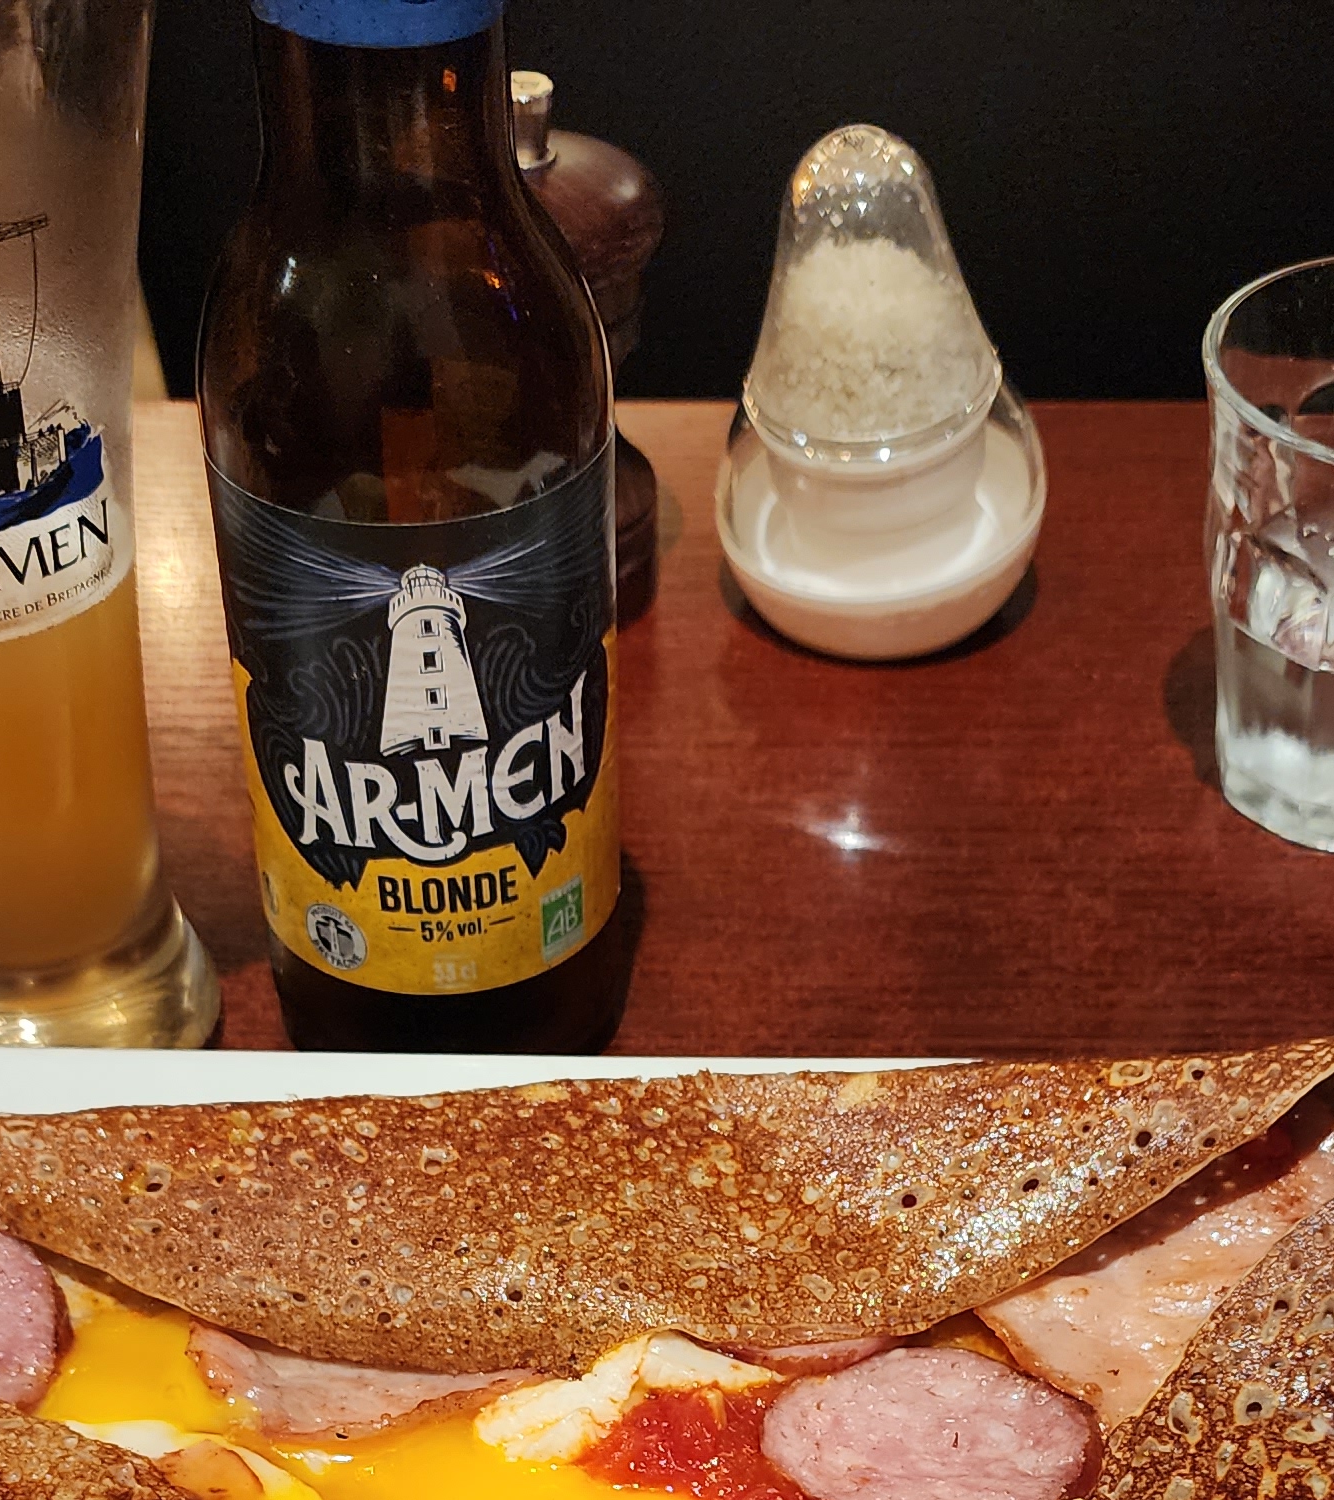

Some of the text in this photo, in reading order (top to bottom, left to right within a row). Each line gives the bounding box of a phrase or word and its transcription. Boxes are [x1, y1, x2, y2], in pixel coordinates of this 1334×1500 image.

[24, 600, 44, 615] DE
[284, 670, 587, 861] AR-MEN
[378, 864, 519, 915] BLONDE
[421, 917, 488, 943] 5% vol.
[547, 903, 579, 943] AB
